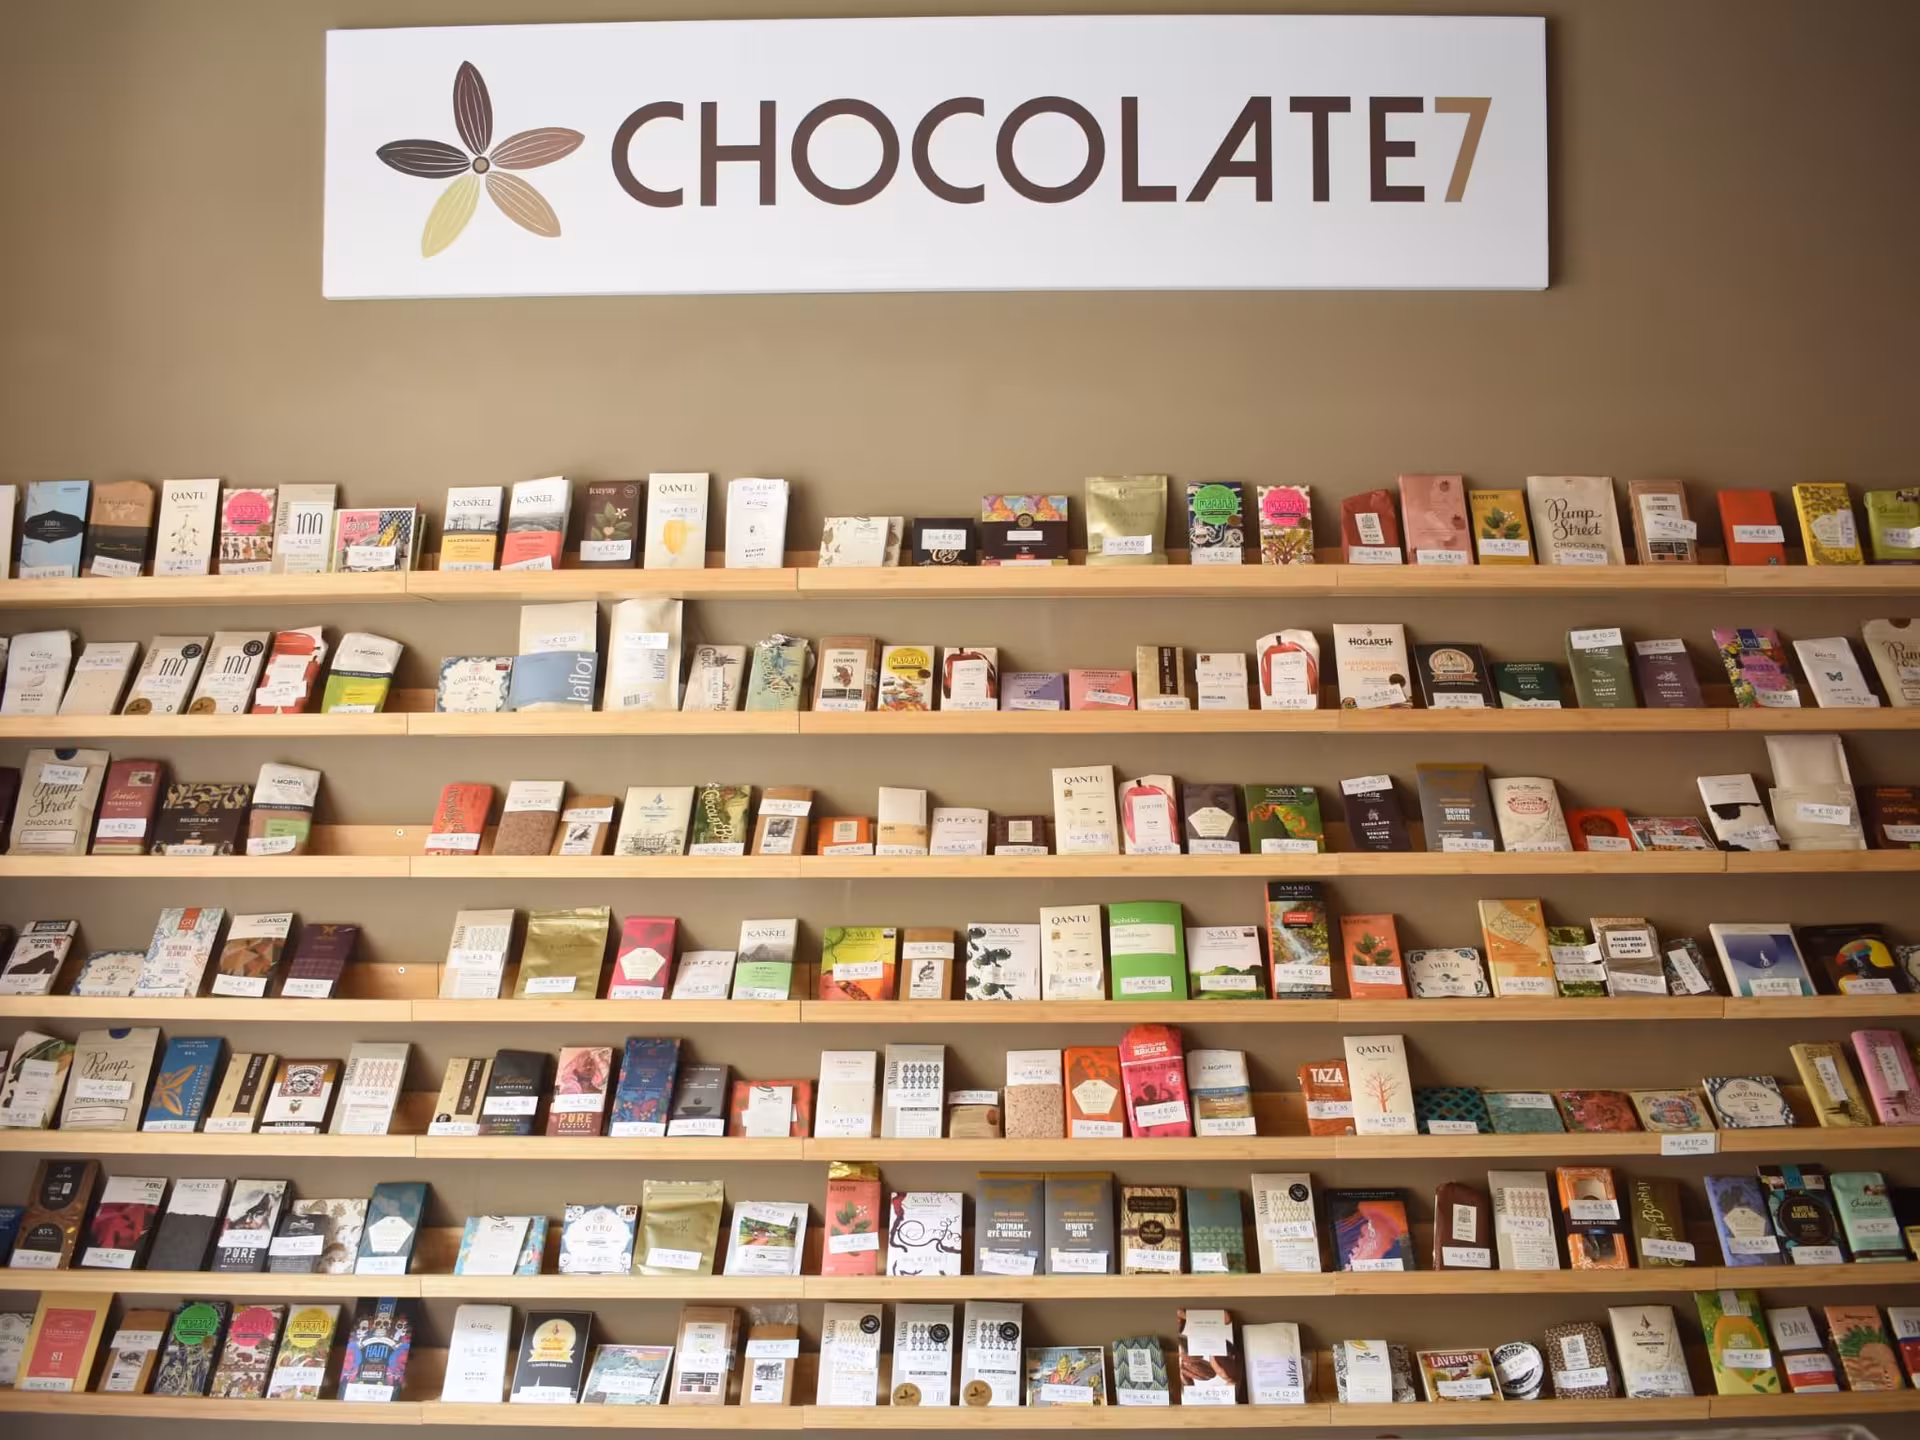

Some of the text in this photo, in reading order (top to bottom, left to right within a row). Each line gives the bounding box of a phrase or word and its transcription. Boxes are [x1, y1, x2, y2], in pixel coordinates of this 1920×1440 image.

[612, 95, 1493, 208] CHOCOLATE7
[659, 482, 697, 493] QANTU
[171, 491, 207, 501] QANTU
[1546, 498, 1602, 524] Pump
[1552, 520, 1601, 540] Street
[1348, 638, 1393, 648] HOGARTH
[567, 653, 595, 702] laflor
[1063, 775, 1103, 786] QANTU
[28, 797, 76, 817] Street
[1051, 915, 1092, 926] QANTU
[1357, 1045, 1394, 1055] QANTU
[86, 1049, 136, 1076] Pump
[1310, 1067, 1344, 1083] TAZA
[559, 1112, 593, 1123] PURE
[995, 1222, 1024, 1230] PUTNAM
[223, 1247, 257, 1259] PURE
[1430, 1354, 1479, 1368] LAVENDER
